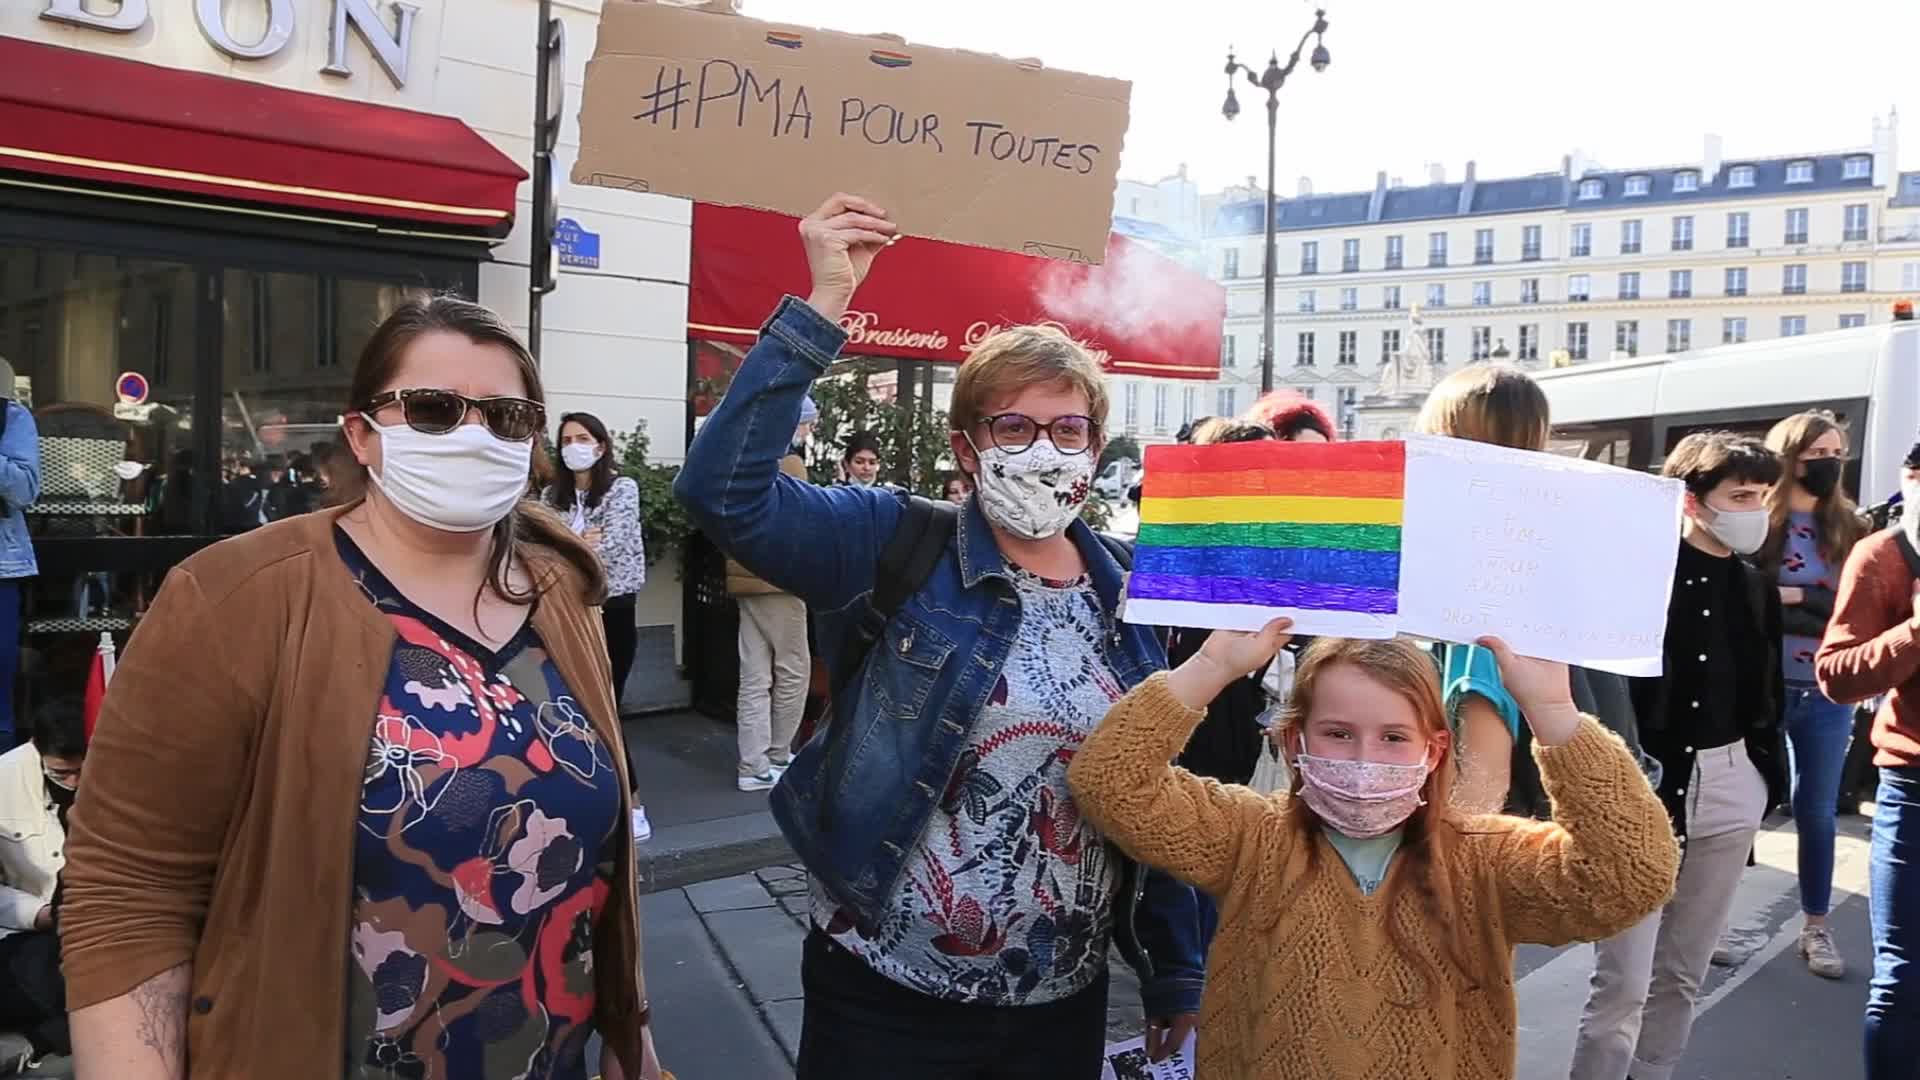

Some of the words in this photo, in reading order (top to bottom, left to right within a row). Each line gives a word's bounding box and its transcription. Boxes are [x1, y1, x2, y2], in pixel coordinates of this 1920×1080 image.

[633, 59, 812, 138] #PMA
[840, 98, 943, 153] POUR
[966, 121, 1101, 175] TOUTES
[836, 310, 949, 350] Brasserie
